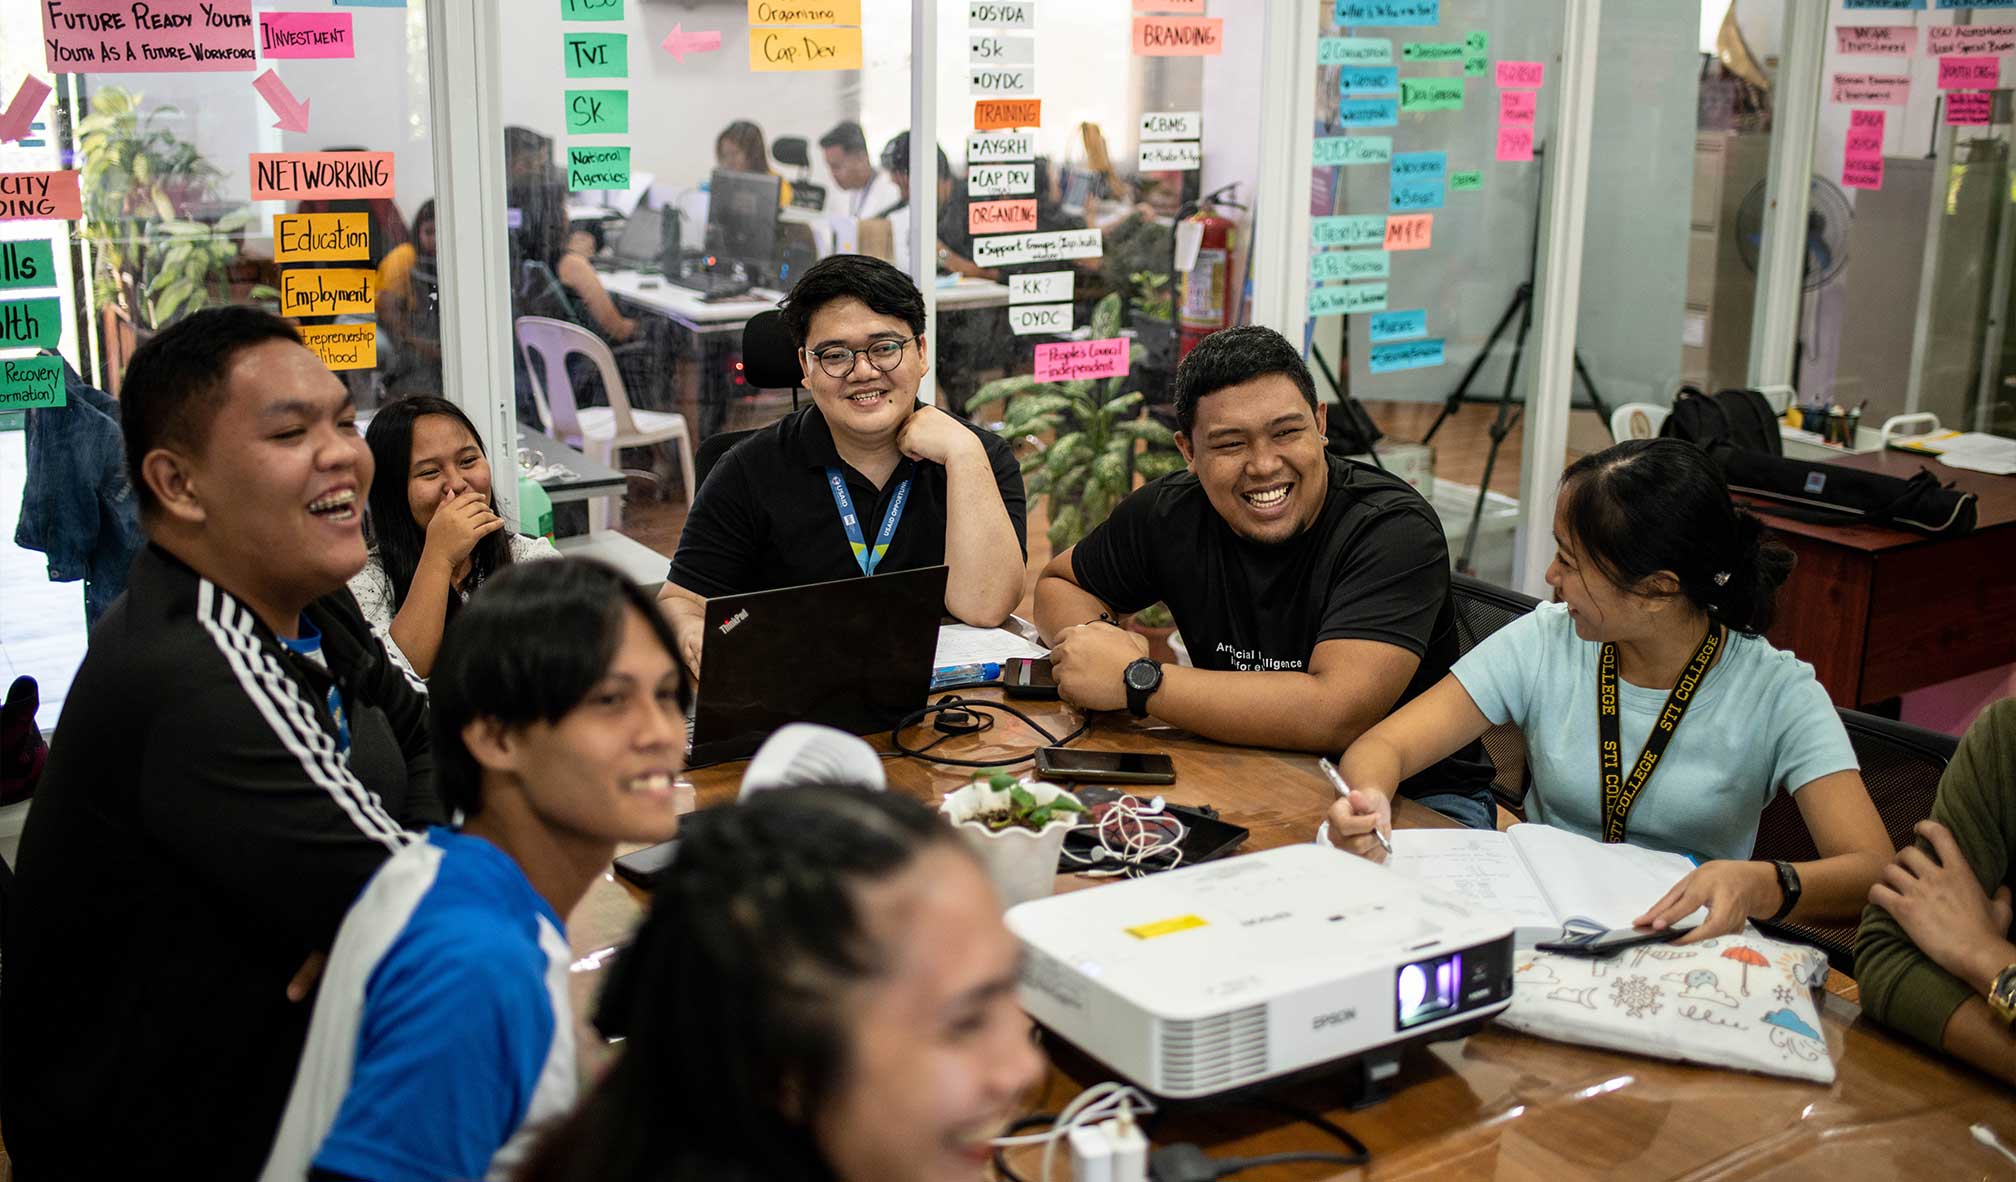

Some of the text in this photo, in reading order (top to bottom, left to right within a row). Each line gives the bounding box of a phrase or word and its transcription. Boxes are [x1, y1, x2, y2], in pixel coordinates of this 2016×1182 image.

[48, 1, 251, 31] FUTURE READY YOUTH
[1143, 23, 1216, 47] BRANDING
[47, 38, 96, 62] YOUTH
[100, 40, 121, 62] AS
[125, 41, 136, 61] A
[981, 72, 1024, 90] OYDC
[977, 103, 1036, 123] TRAINING
[979, 138, 1027, 155] AYSRH
[257, 160, 390, 191] NETWORKING
[280, 219, 368, 253] Education
[285, 275, 372, 312] Employment
[6, 361, 61, 388] Recovery
[836, 484, 849, 508] USAID
[883, 516, 896, 537] USAID
[718, 608, 749, 635] ThinkPad
[1602, 645, 1616, 716] COLLEGE
[1660, 634, 1719, 732] STI COLLEGE
[1604, 741, 1618, 769] STI
[1615, 750, 1658, 817] COLLEGE
